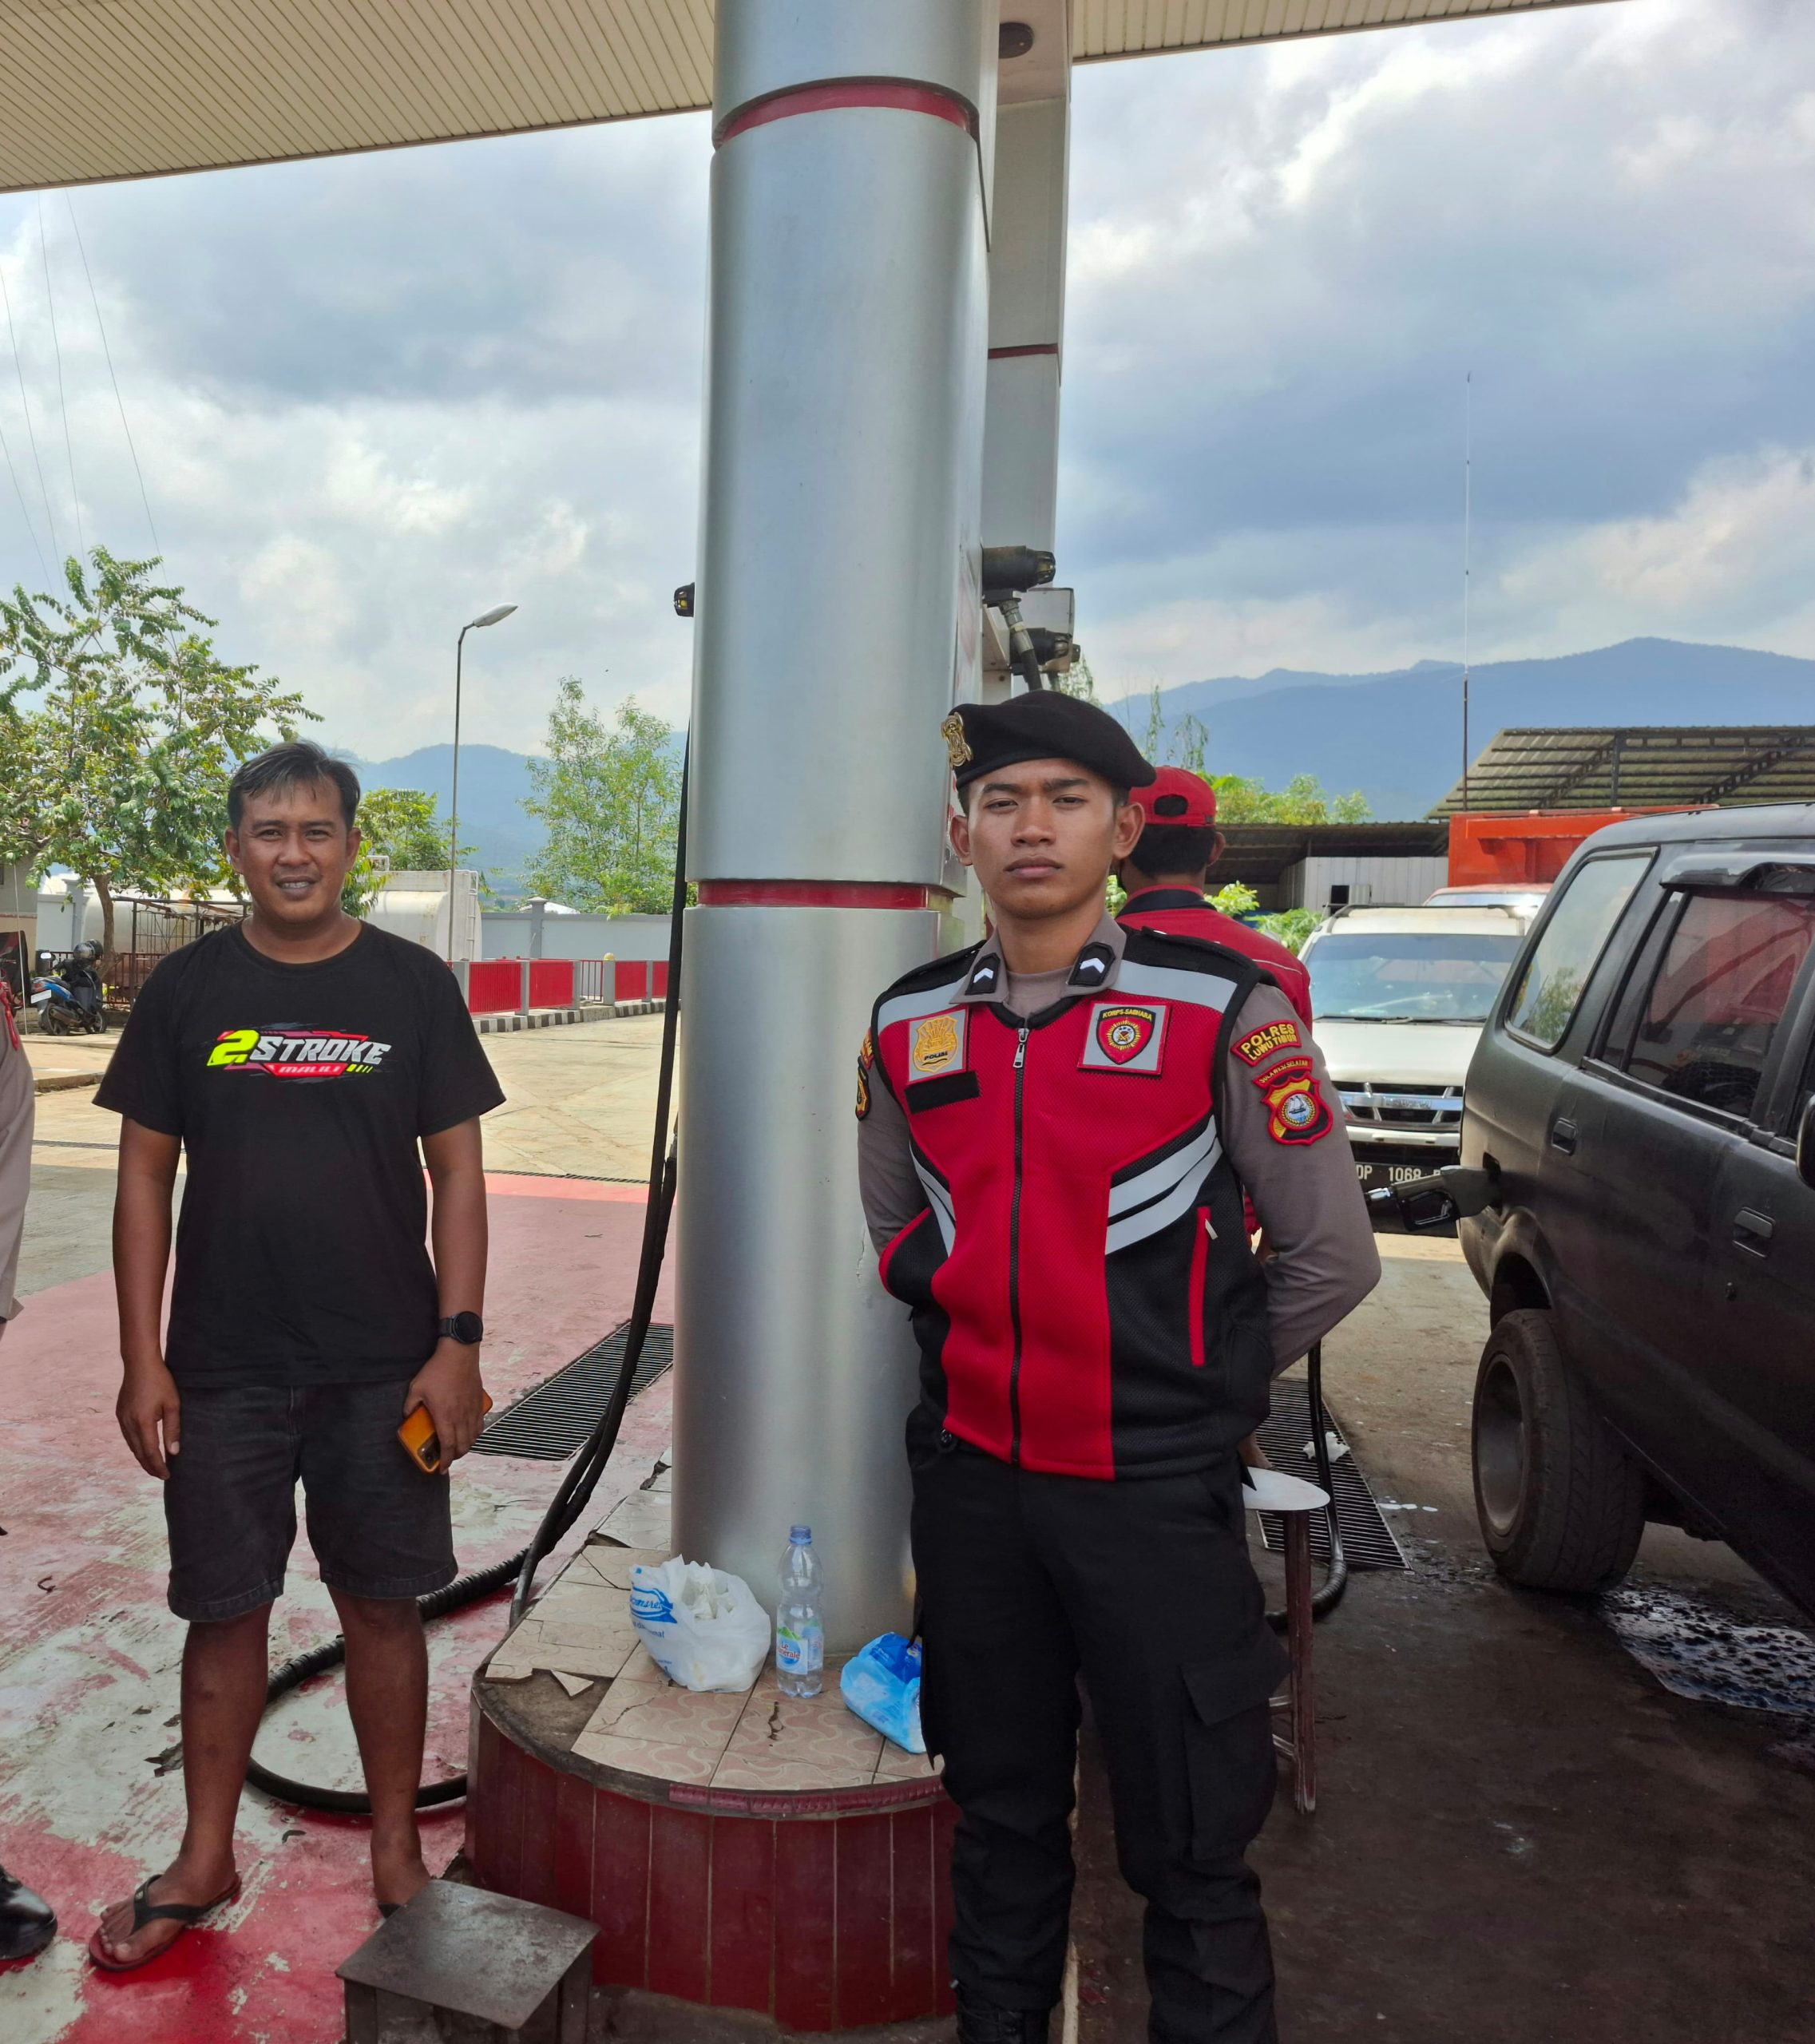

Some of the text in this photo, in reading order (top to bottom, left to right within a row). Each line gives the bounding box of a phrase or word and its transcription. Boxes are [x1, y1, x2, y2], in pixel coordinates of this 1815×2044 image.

[1241, 1024, 1295, 1054] POLRES
[1248, 1034, 1298, 1060] LUWU TIMUR
[1258, 1060, 1309, 1083] SULAWESI SELATAN
[1356, 1164, 1373, 1180] DP
[1389, 1167, 1421, 1182] 1068
